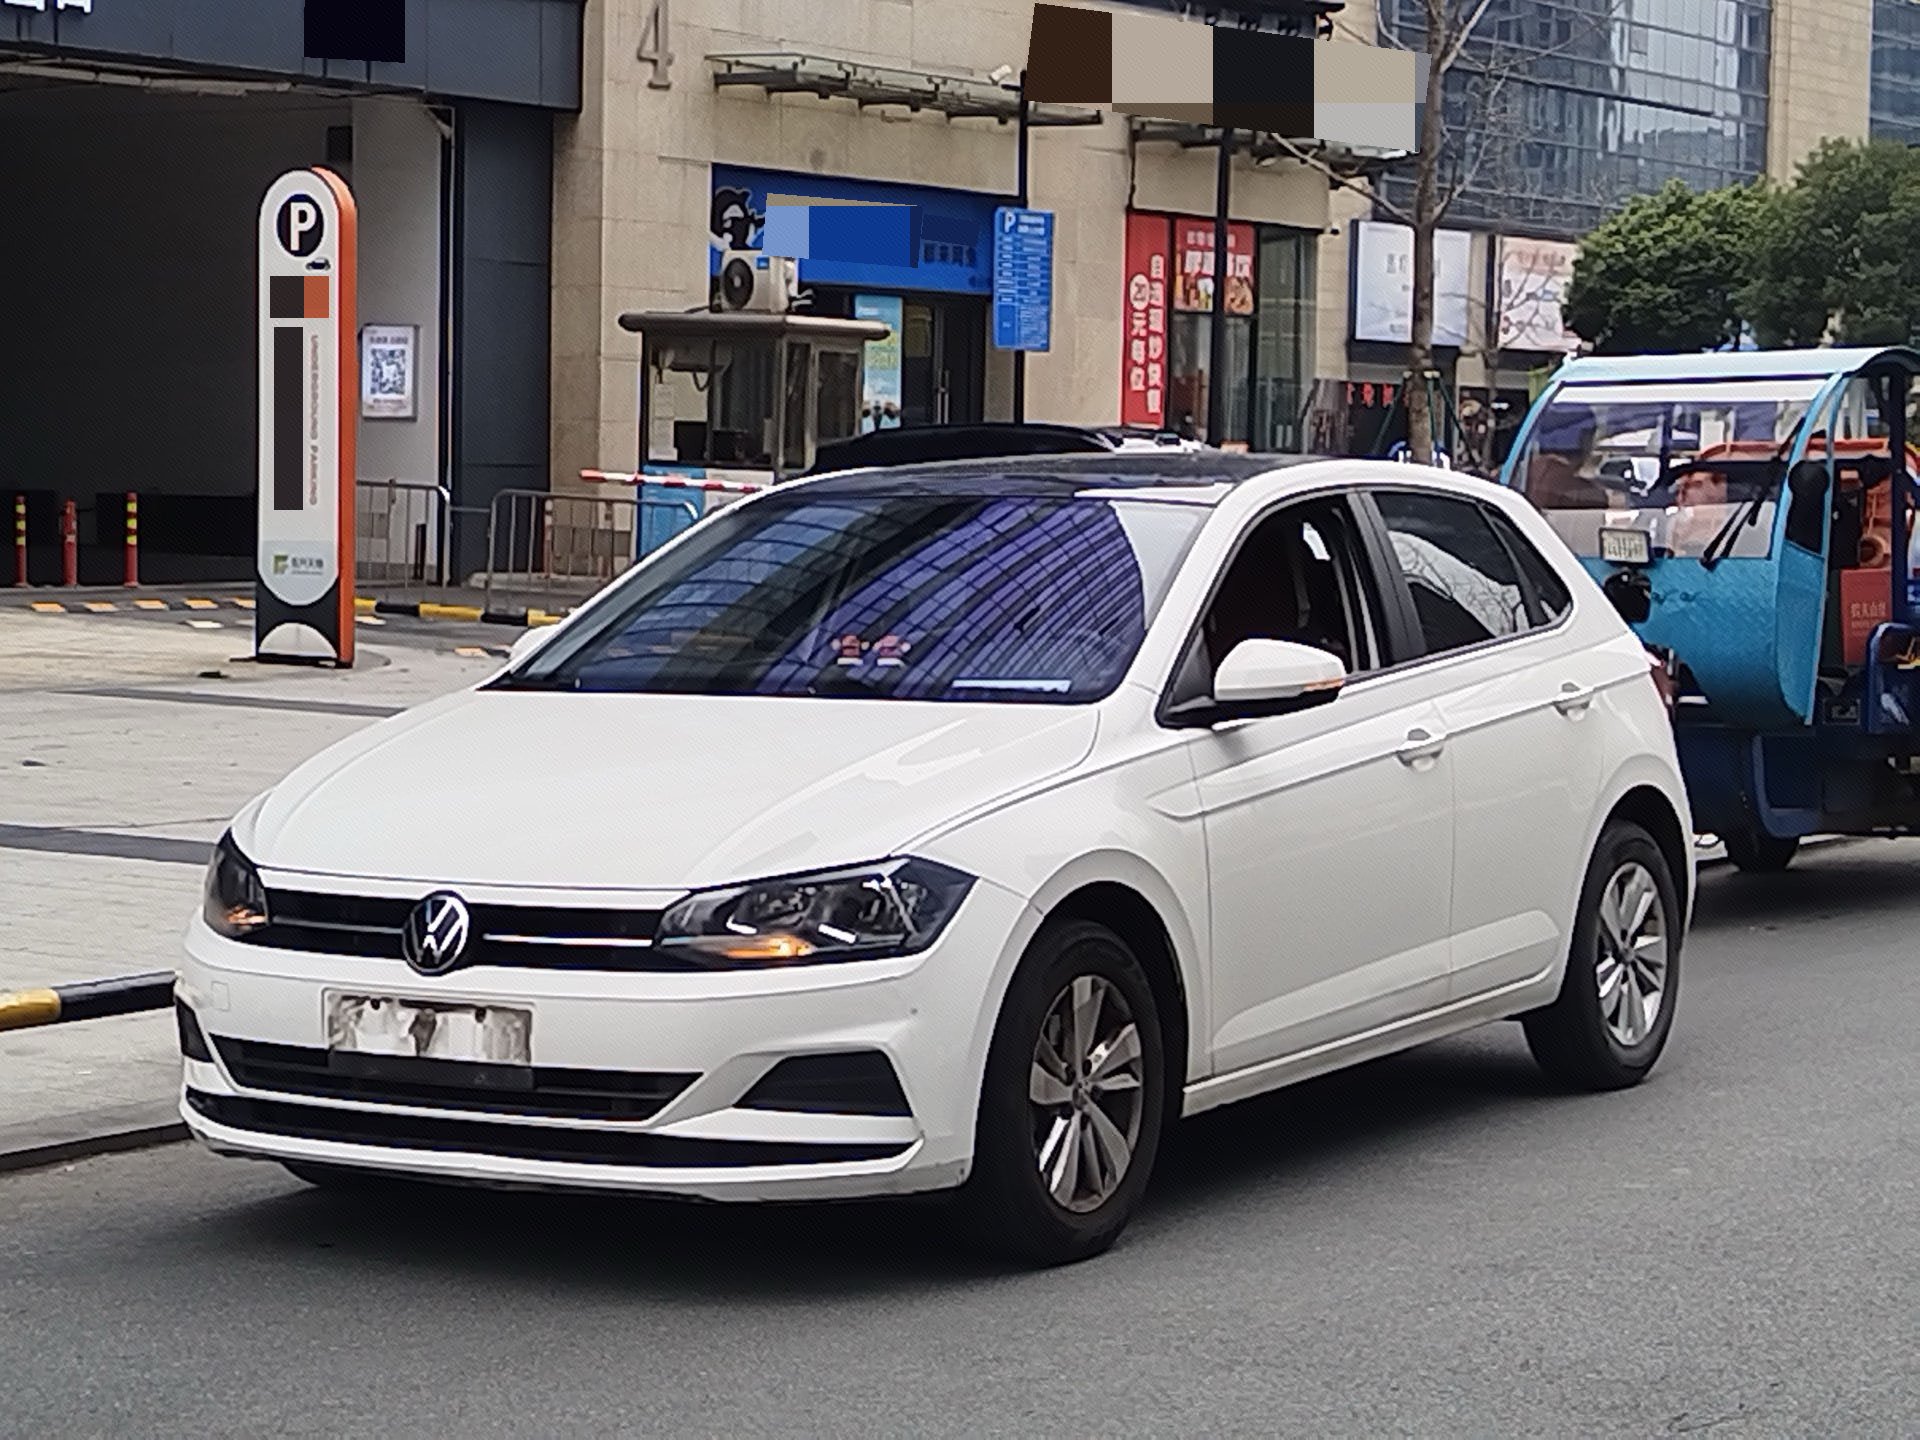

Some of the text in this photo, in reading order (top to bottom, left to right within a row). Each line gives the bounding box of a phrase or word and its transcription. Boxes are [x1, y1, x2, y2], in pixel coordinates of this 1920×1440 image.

[637, 0, 675, 92] 4
[290, 201, 317, 251] P
[1005, 212, 1016, 232] P
[309, 445, 318, 506] PARKING
